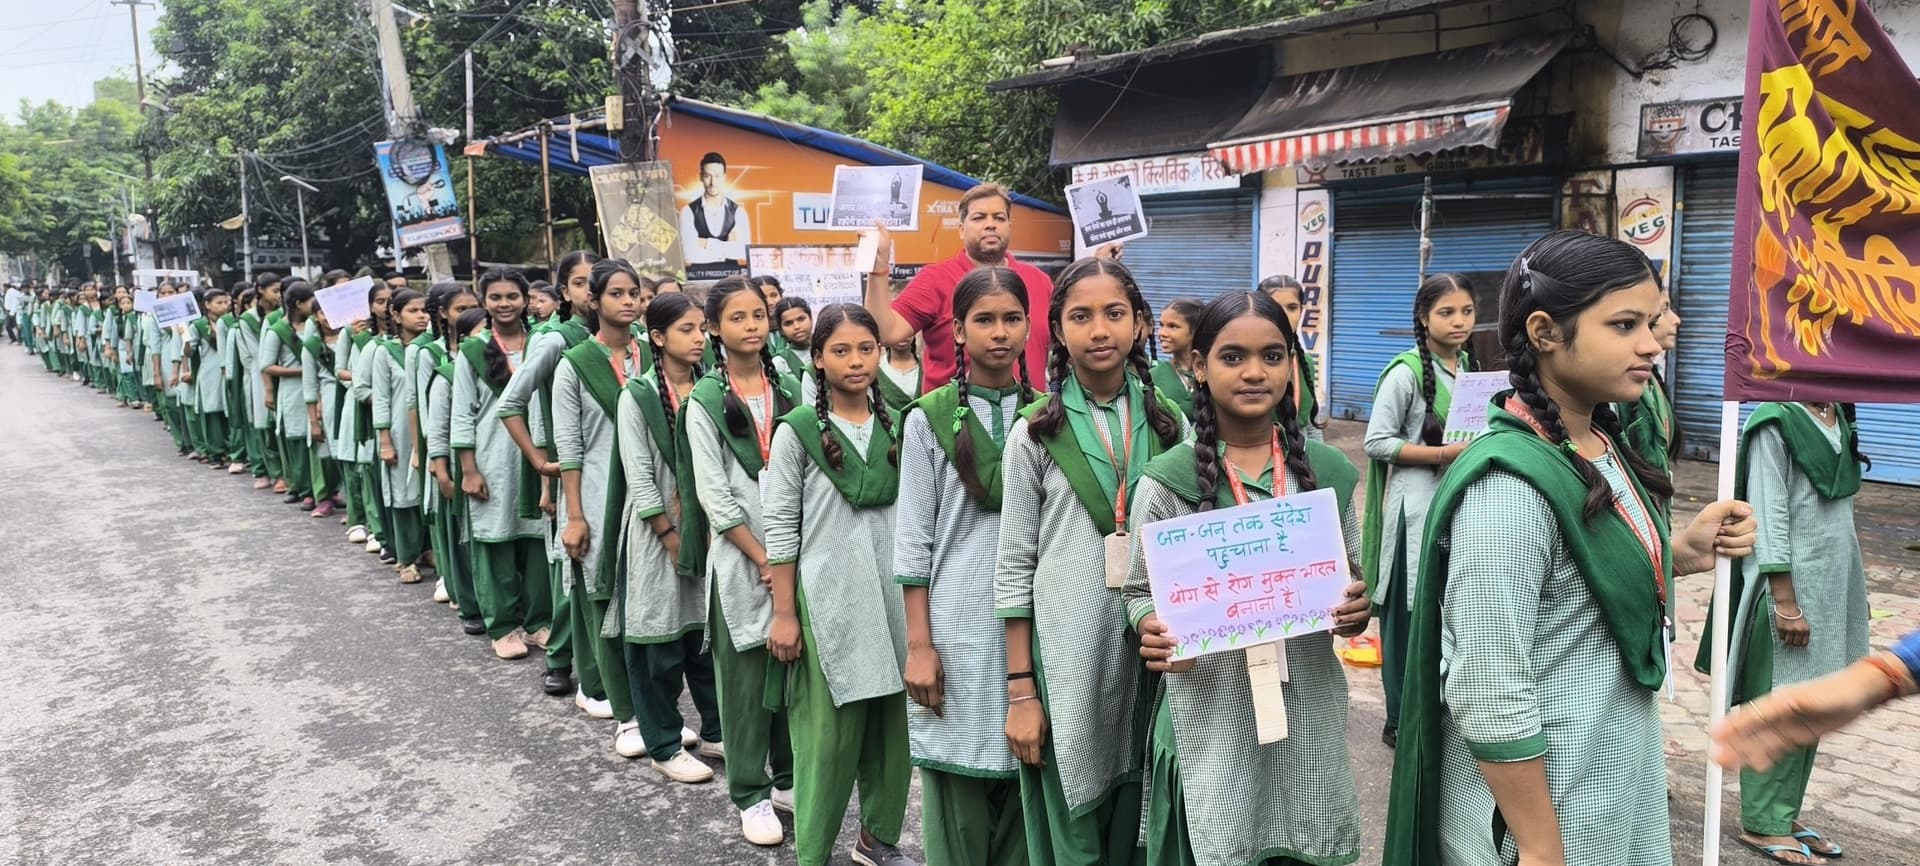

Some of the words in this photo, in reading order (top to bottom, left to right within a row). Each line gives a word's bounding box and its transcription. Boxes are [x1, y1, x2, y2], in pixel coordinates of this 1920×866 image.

[1341, 166, 1377, 178] TASTE
[1395, 165, 1407, 174] OF
[1303, 213, 1325, 231] VEG
[1624, 216, 1664, 238] VEG
[1301, 241, 1321, 328] PURE
[1233, 514, 1264, 535] तक
[1270, 503, 1312, 527] संदेश
[1169, 583, 1201, 606] योग
[1204, 576, 1220, 601] से
[1228, 573, 1254, 594] रोग
[1261, 568, 1297, 593] मुक्त
[1300, 560, 1337, 579] भारत
[1226, 595, 1276, 619] बनाना
